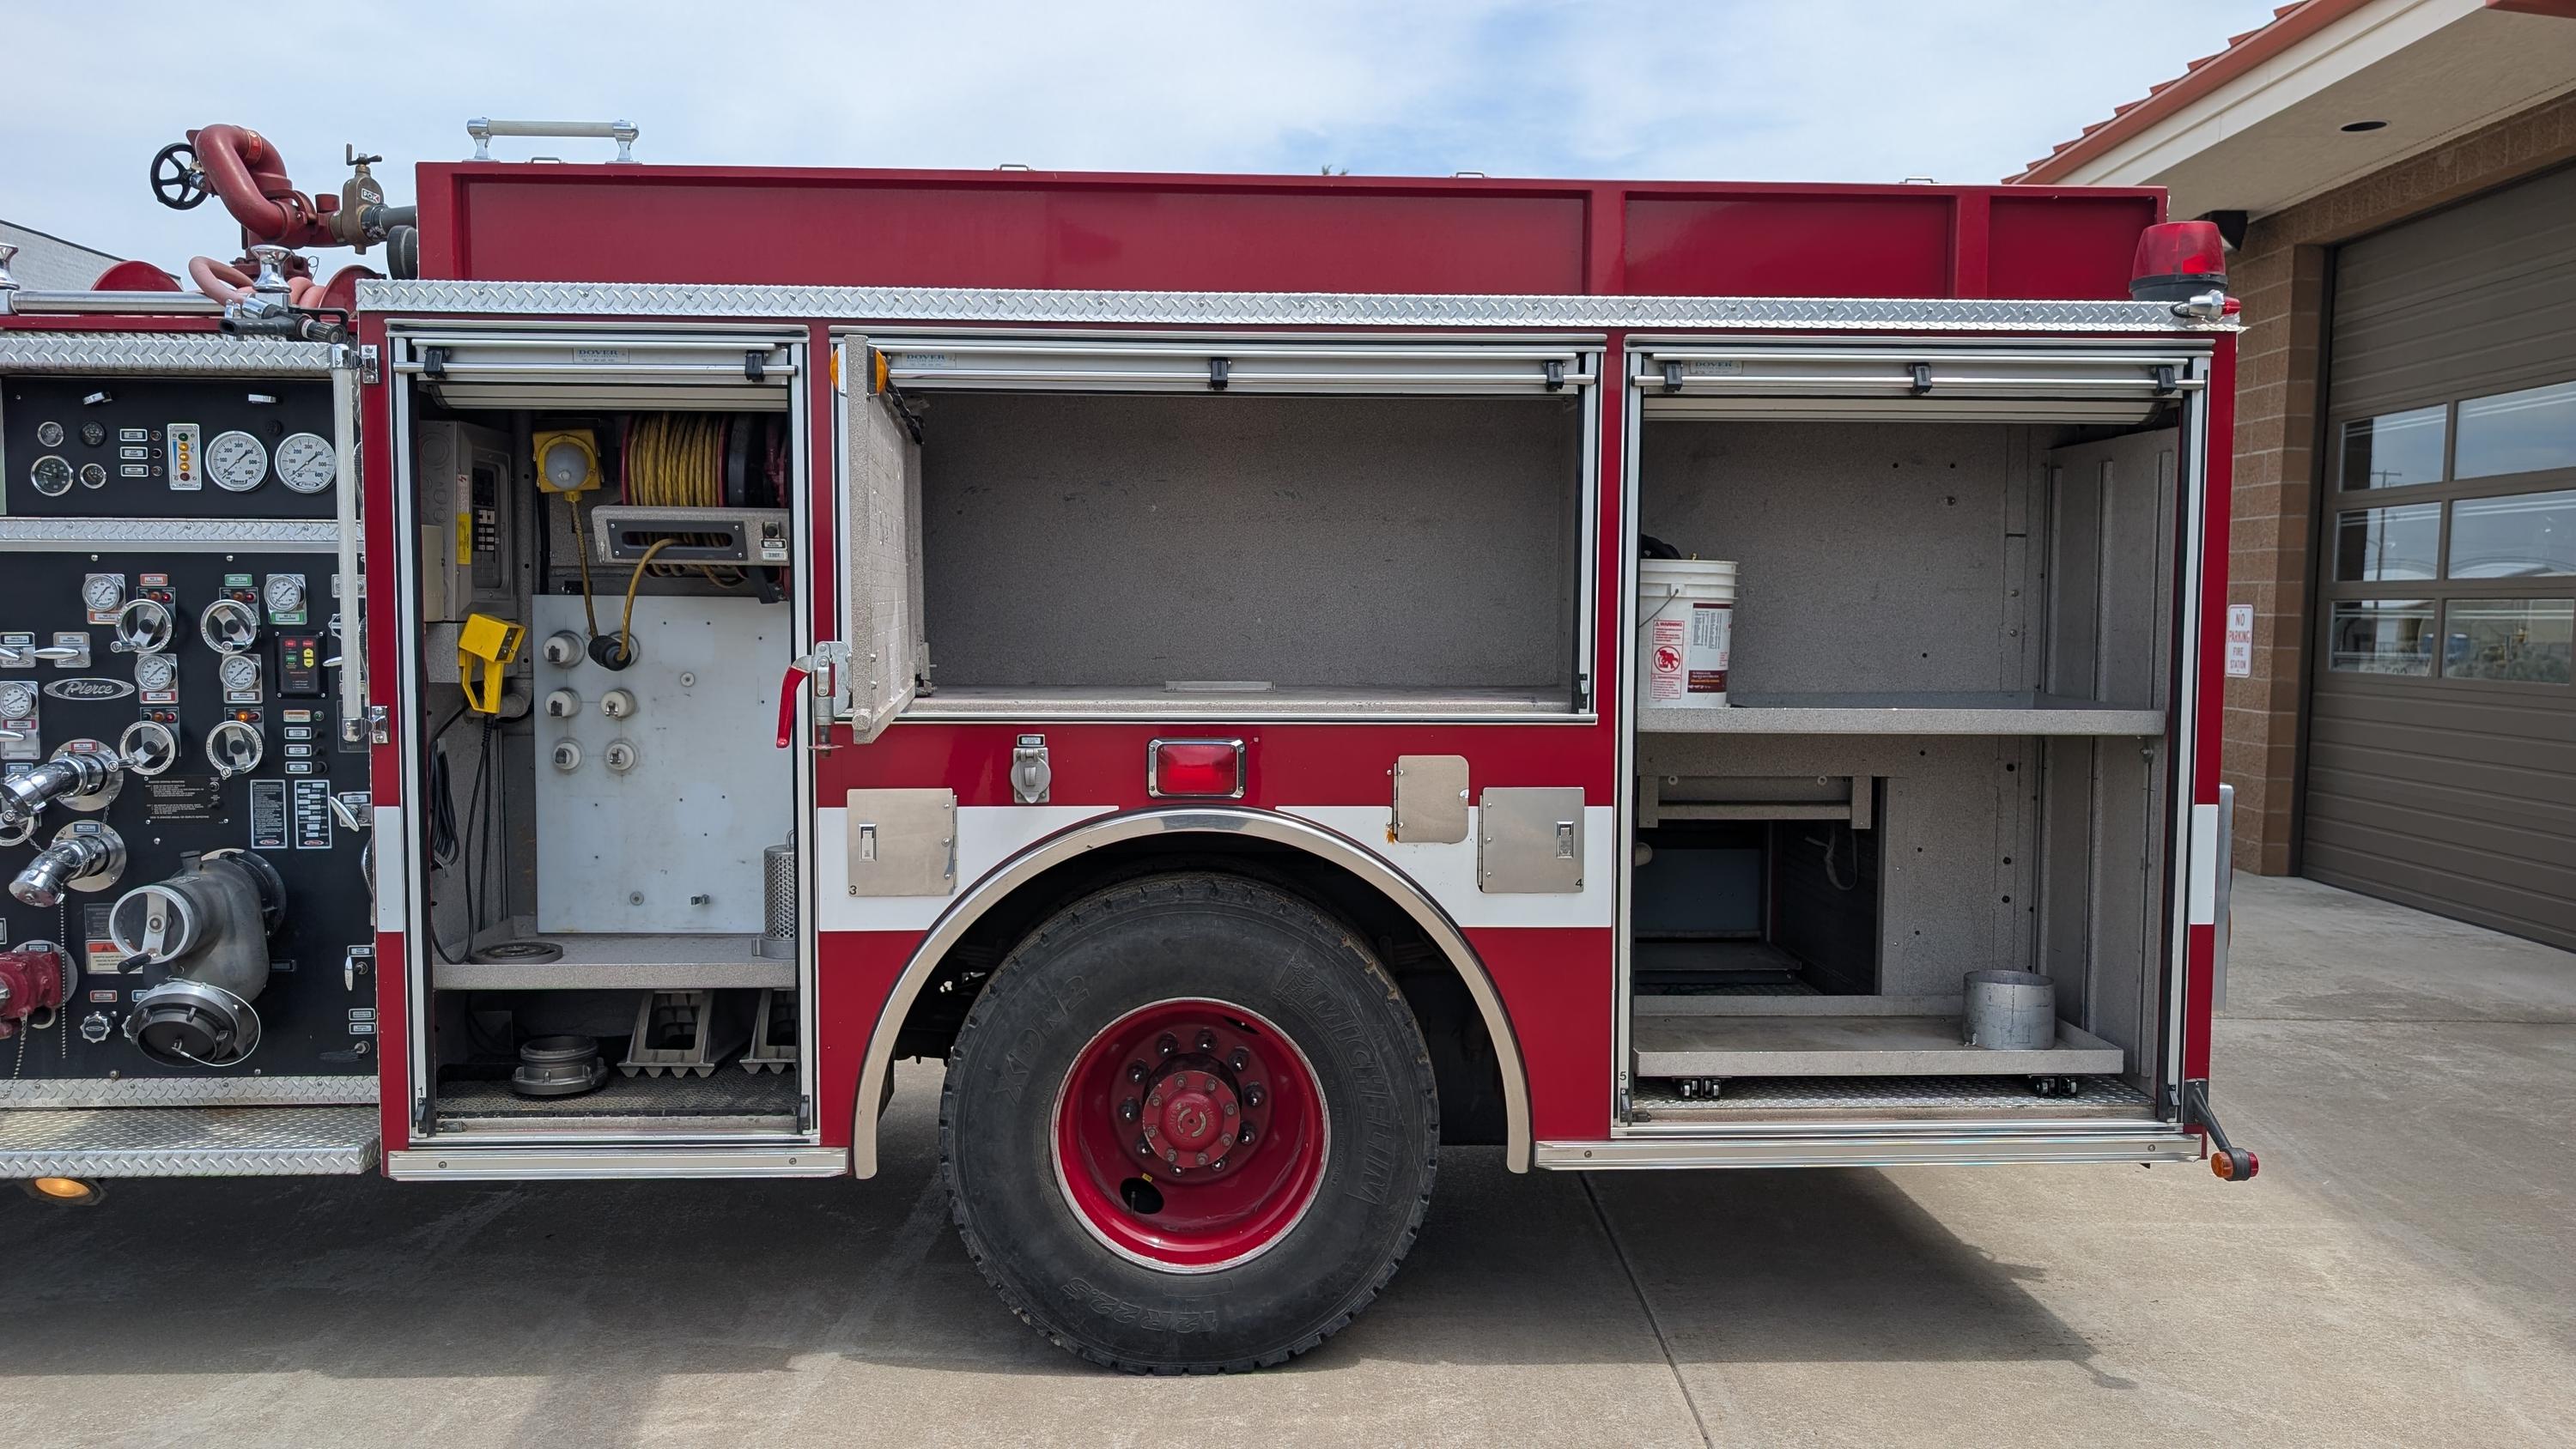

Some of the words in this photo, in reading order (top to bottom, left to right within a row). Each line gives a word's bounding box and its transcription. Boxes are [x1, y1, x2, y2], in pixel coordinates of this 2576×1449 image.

[363, 190, 380, 203] POK
[2235, 613, 2245, 627] NO
[2228, 630, 2250, 643] PARKING
[2233, 646, 2244, 656] FIRE
[2230, 659, 2246, 670] STATION
[64, 681, 113, 696] Pierce
[1575, 878, 1583, 888] 4
[848, 885, 857, 895] 3
[1619, 1070, 1627, 1081] 5
[417, 1086, 423, 1097] 1
[1303, 989, 1393, 1206] MICHELIN
